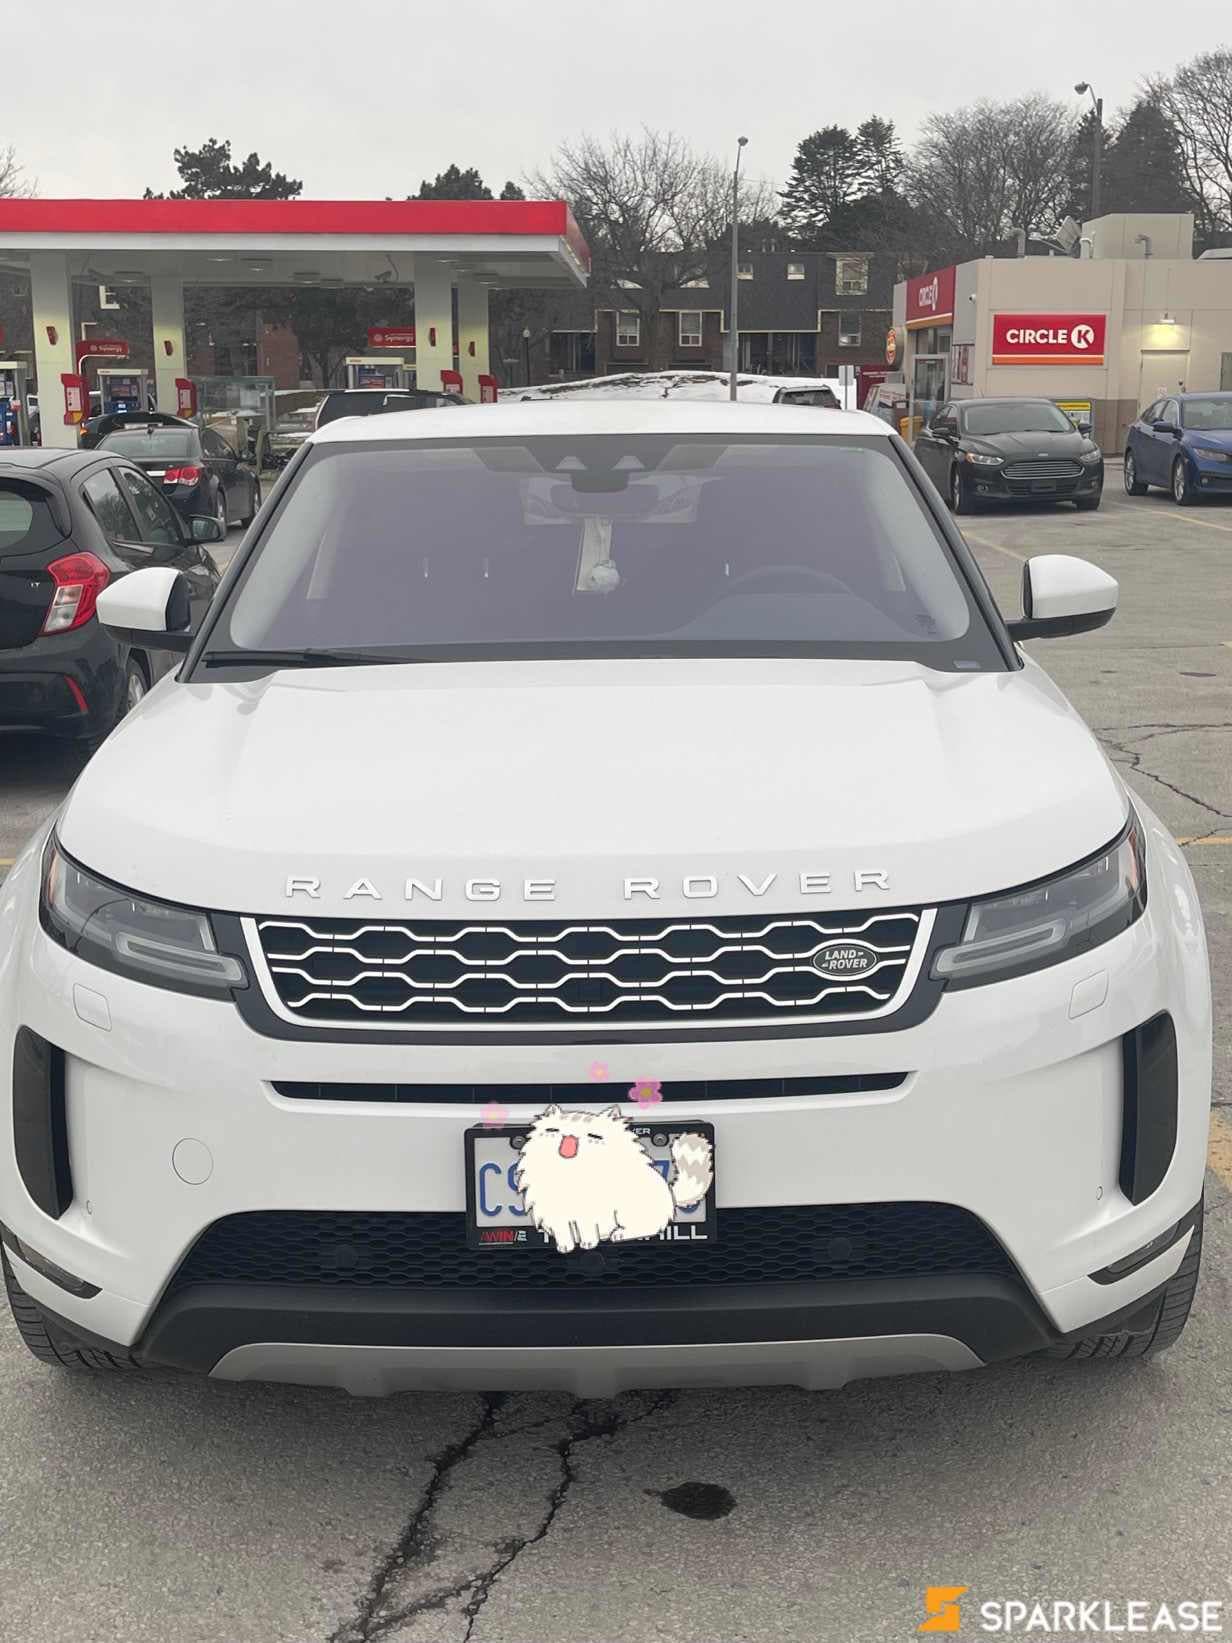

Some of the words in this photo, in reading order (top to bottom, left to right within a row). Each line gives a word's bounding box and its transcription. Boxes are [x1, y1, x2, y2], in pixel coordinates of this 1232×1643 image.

[1006, 329, 1068, 344] CIRCLE
[1073, 326, 1095, 349] K
[285, 875, 556, 901] RANGE
[623, 869, 890, 900] ROVER
[829, 958, 868, 970] ROVER
